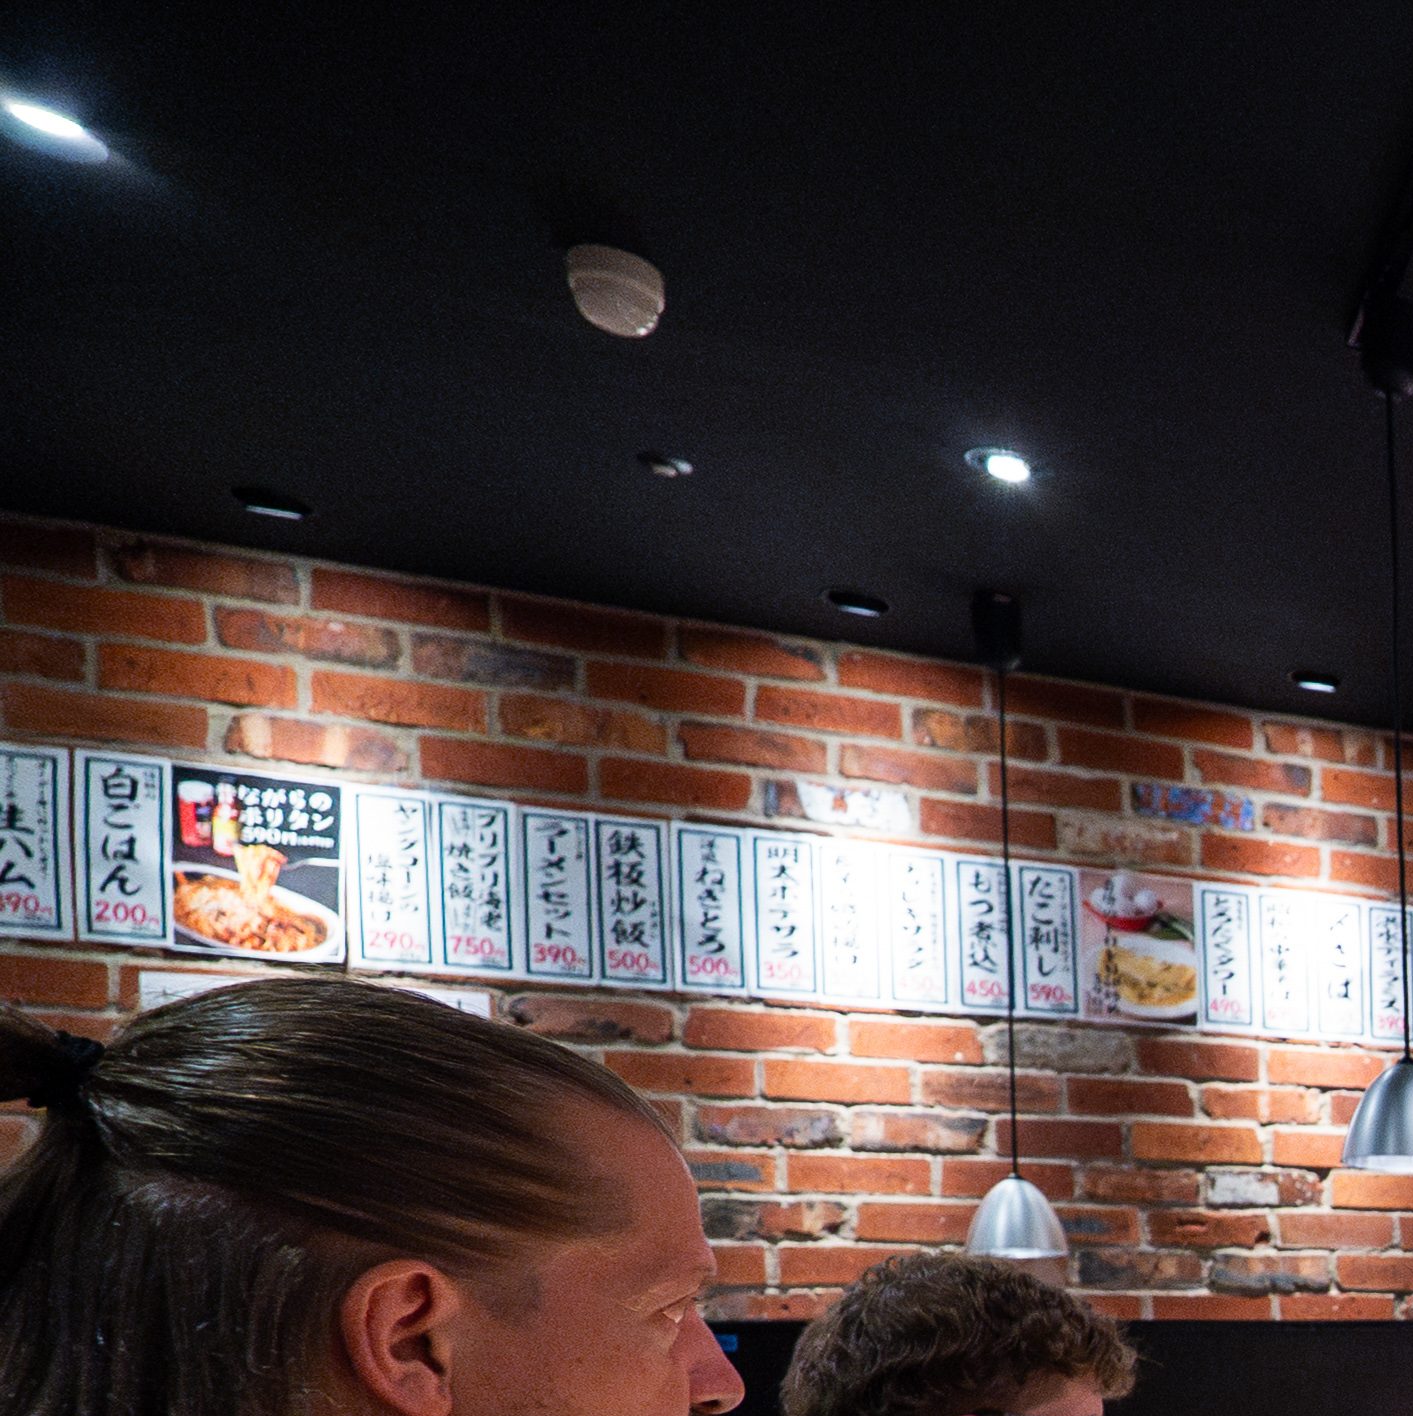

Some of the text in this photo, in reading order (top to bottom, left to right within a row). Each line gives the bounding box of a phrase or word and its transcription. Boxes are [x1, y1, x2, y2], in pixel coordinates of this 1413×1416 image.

[99, 765, 142, 897] 白ごはん
[605, 829, 650, 948] 鉄板炒飯
[1029, 874, 1060, 978] たこ刺し
